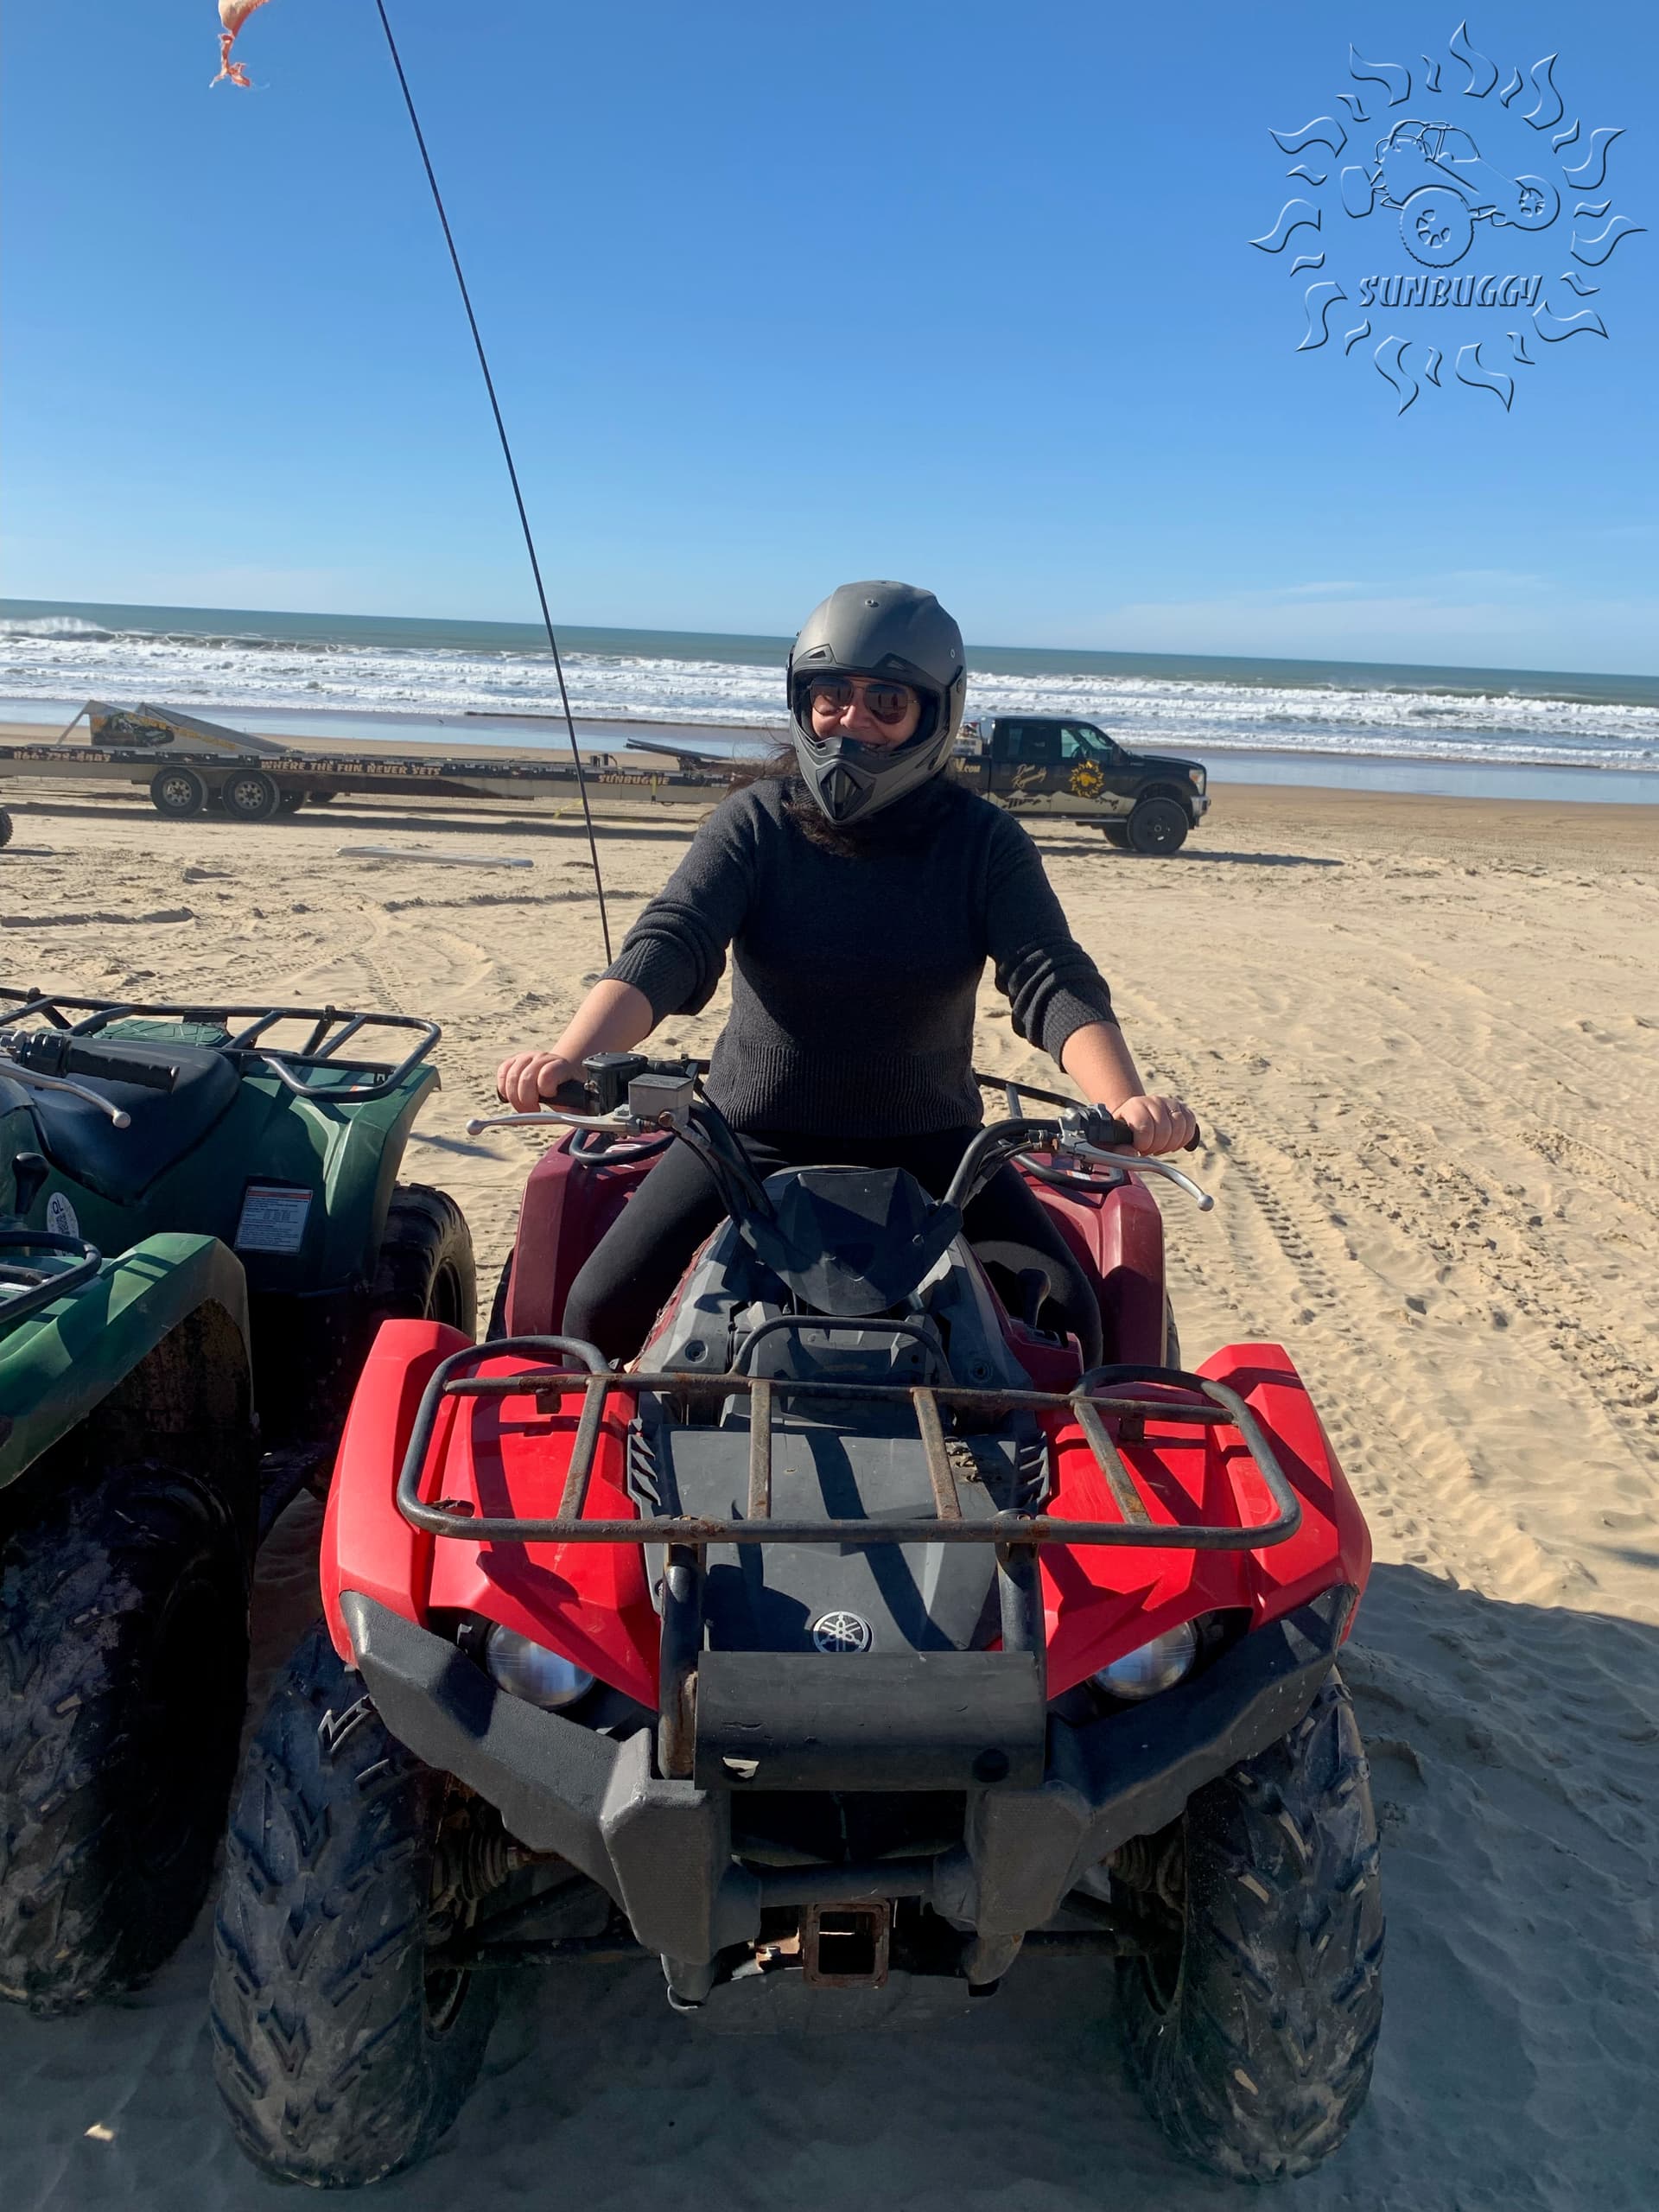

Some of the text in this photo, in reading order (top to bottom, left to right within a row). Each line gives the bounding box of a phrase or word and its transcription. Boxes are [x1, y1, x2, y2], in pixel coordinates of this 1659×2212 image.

[261, 760, 442, 776] WHERE THE FUN NEVER SETS
